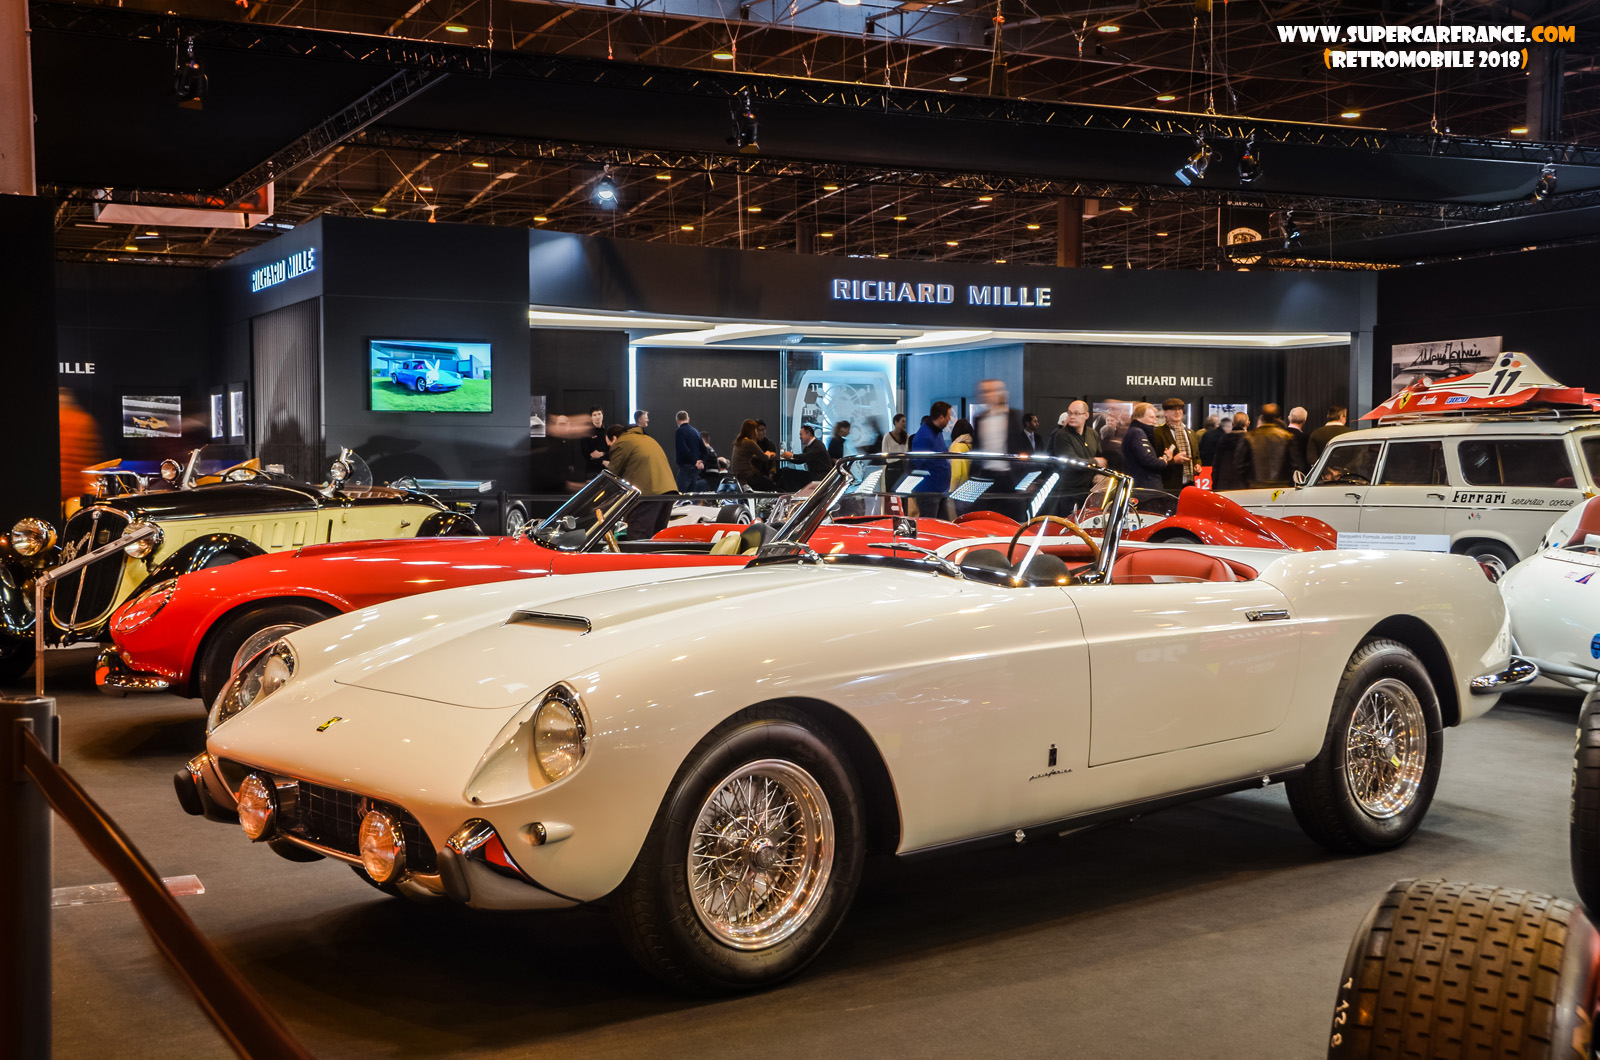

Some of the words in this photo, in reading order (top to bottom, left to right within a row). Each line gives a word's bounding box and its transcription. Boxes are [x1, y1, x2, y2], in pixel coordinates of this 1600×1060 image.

[252, 260, 286, 293] RICHARD
[287, 247, 316, 279] MILLE
[832, 278, 955, 303] RICHARD
[968, 285, 1052, 307] MILLE
[59, 362, 95, 374] ILLE
[683, 377, 738, 388] RICHARD
[741, 379, 778, 389] MILLE
[1126, 375, 1177, 386] RICHARD
[1180, 376, 1213, 386] MILLE
[1488, 369, 1523, 396] 11
[1195, 478, 1210, 489] 12
[1452, 490, 1507, 504] Ferrari
[1549, 499, 1574, 507] corse
